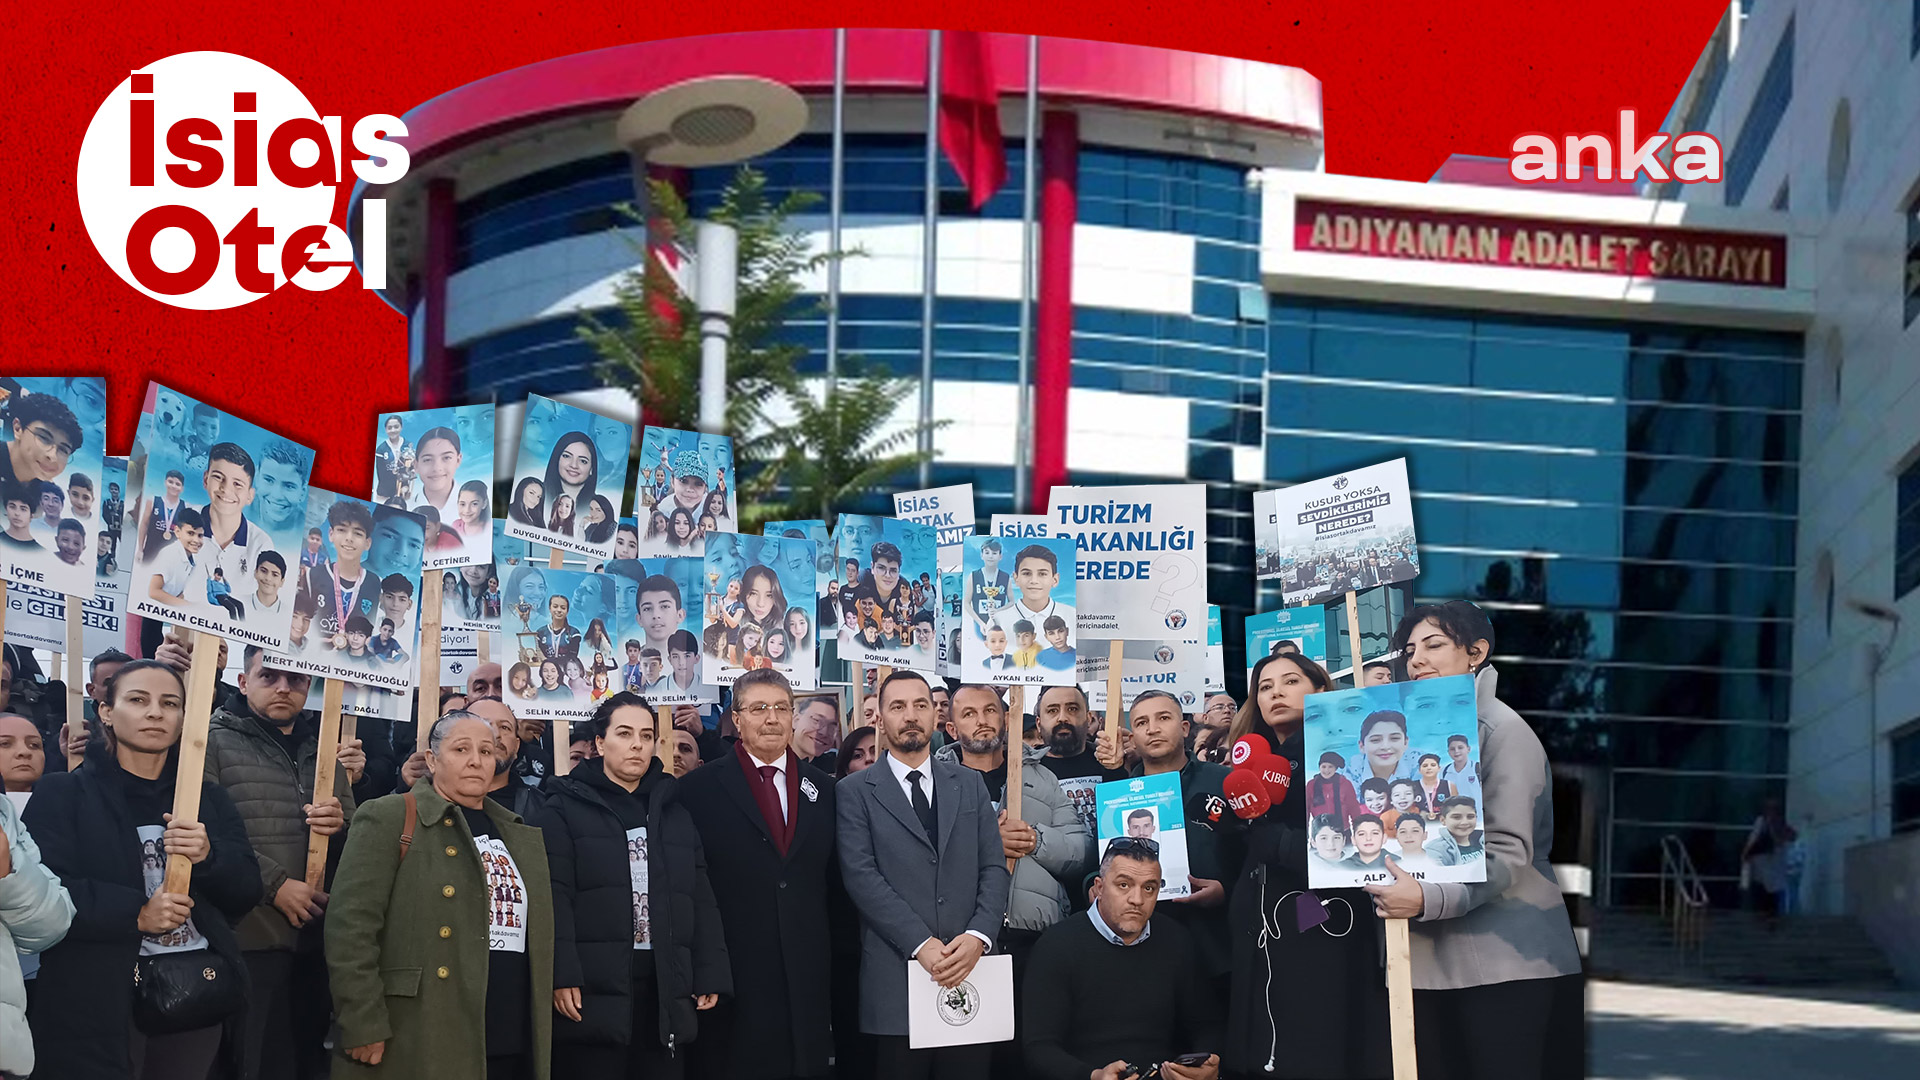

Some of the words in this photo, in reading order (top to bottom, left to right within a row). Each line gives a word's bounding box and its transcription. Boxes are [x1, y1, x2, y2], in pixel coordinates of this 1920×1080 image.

[1310, 213, 1499, 262] ADIYAMAN
[1510, 230, 1640, 271] ADALET
[1648, 240, 1773, 284] SARAYI
[898, 496, 940, 513] İSİAS
[1304, 494, 1341, 510] KUSUR
[1343, 485, 1382, 500] YOKSA
[1057, 500, 1152, 524] TURİZM
[1299, 494, 1389, 524] SEVDİKLERİMİZ
[999, 521, 1048, 538] İSİAS
[1317, 513, 1372, 533] NEREDE?
[513, 528, 541, 541] DUYGU
[542, 535, 573, 550] BOLSOY
[574, 544, 607, 558] KALAYCI
[937, 526, 974, 545] AMIZ
[433, 556, 471, 567] ÇETİNER
[10, 564, 45, 582] İÇME
[1076, 561, 1150, 580] EREDE
[95, 581, 118, 590] LTAK
[6, 595, 23, 611] le
[137, 602, 187, 622] ATAKAN
[189, 616, 226, 633] CELAL
[229, 626, 281, 647] KONUKLU
[441, 635, 470, 646] diyor!
[864, 653, 890, 663] DORUK
[893, 658, 911, 666] AKIN
[1076, 657, 1109, 665] akdavamız
[263, 655, 293, 667] MERT
[296, 661, 331, 674] NİYAZİ
[334, 667, 409, 687] TOPUKÇUOĞLU
[993, 674, 1021, 682] AYKAN
[1025, 674, 1044, 682] EKİZ
[690, 694, 698, 702] İŞ
[354, 703, 380, 714] DAĞLI
[525, 707, 550, 716] SELİN
[1228, 792, 1258, 811] sim
[1363, 873, 1387, 882] ALP
